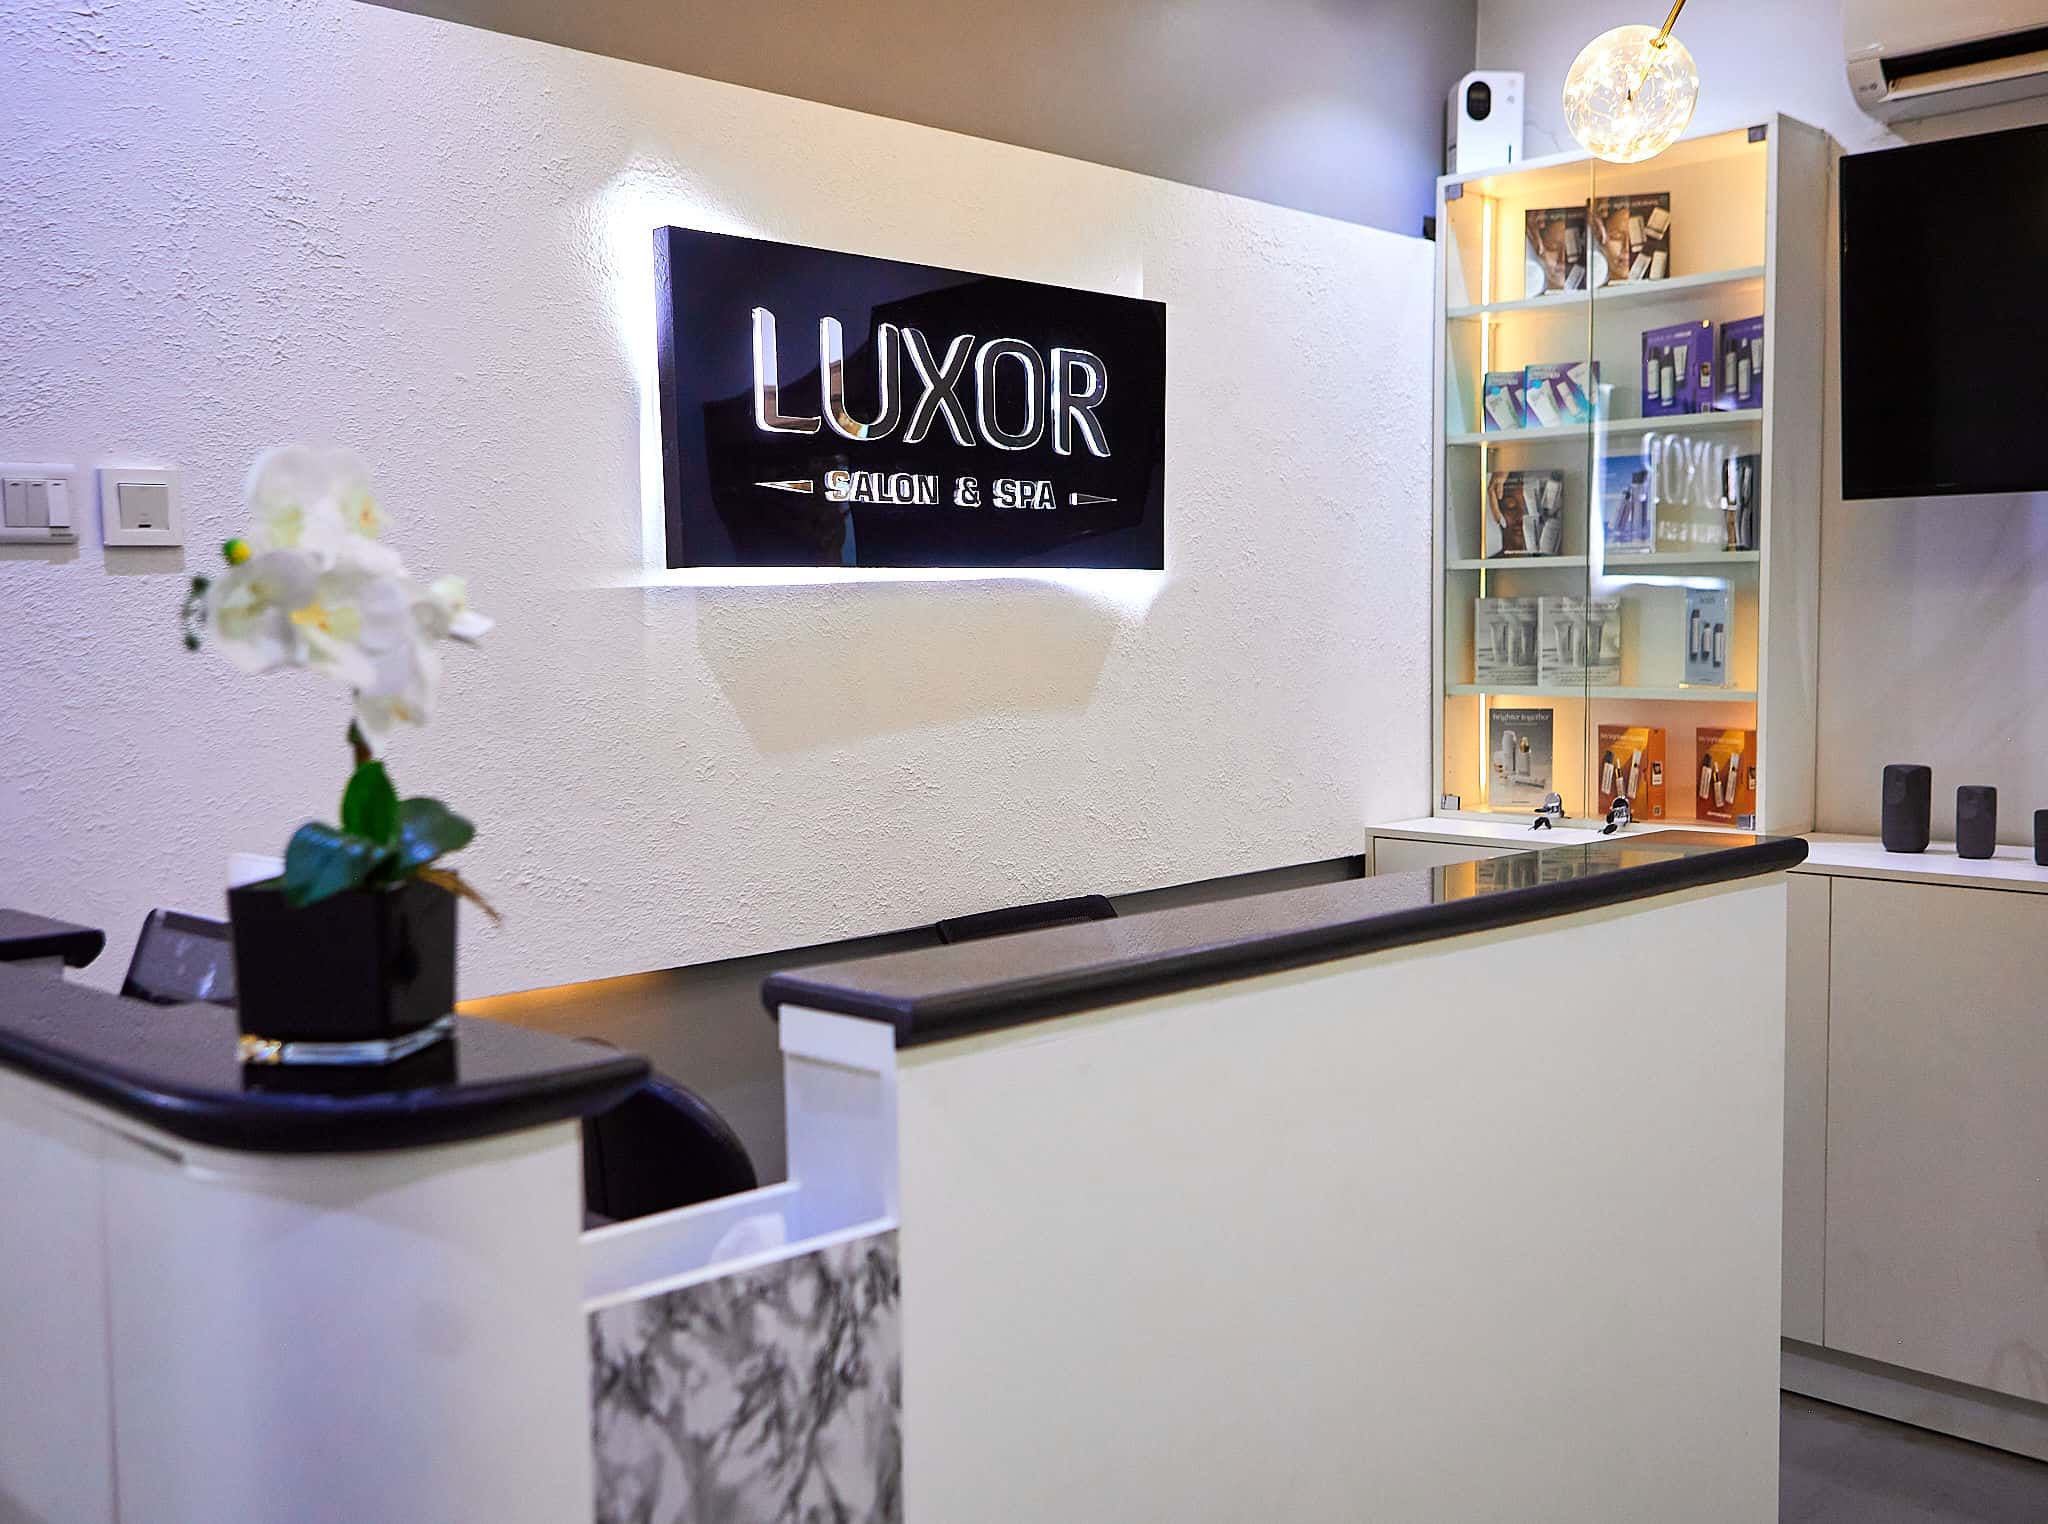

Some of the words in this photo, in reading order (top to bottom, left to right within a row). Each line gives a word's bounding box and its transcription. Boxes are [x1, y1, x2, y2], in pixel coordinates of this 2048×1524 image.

[752, 306, 1111, 457] LUXOR
[824, 470, 940, 505] SALON
[953, 477, 981, 508] &
[992, 479, 1057, 510] SPA
